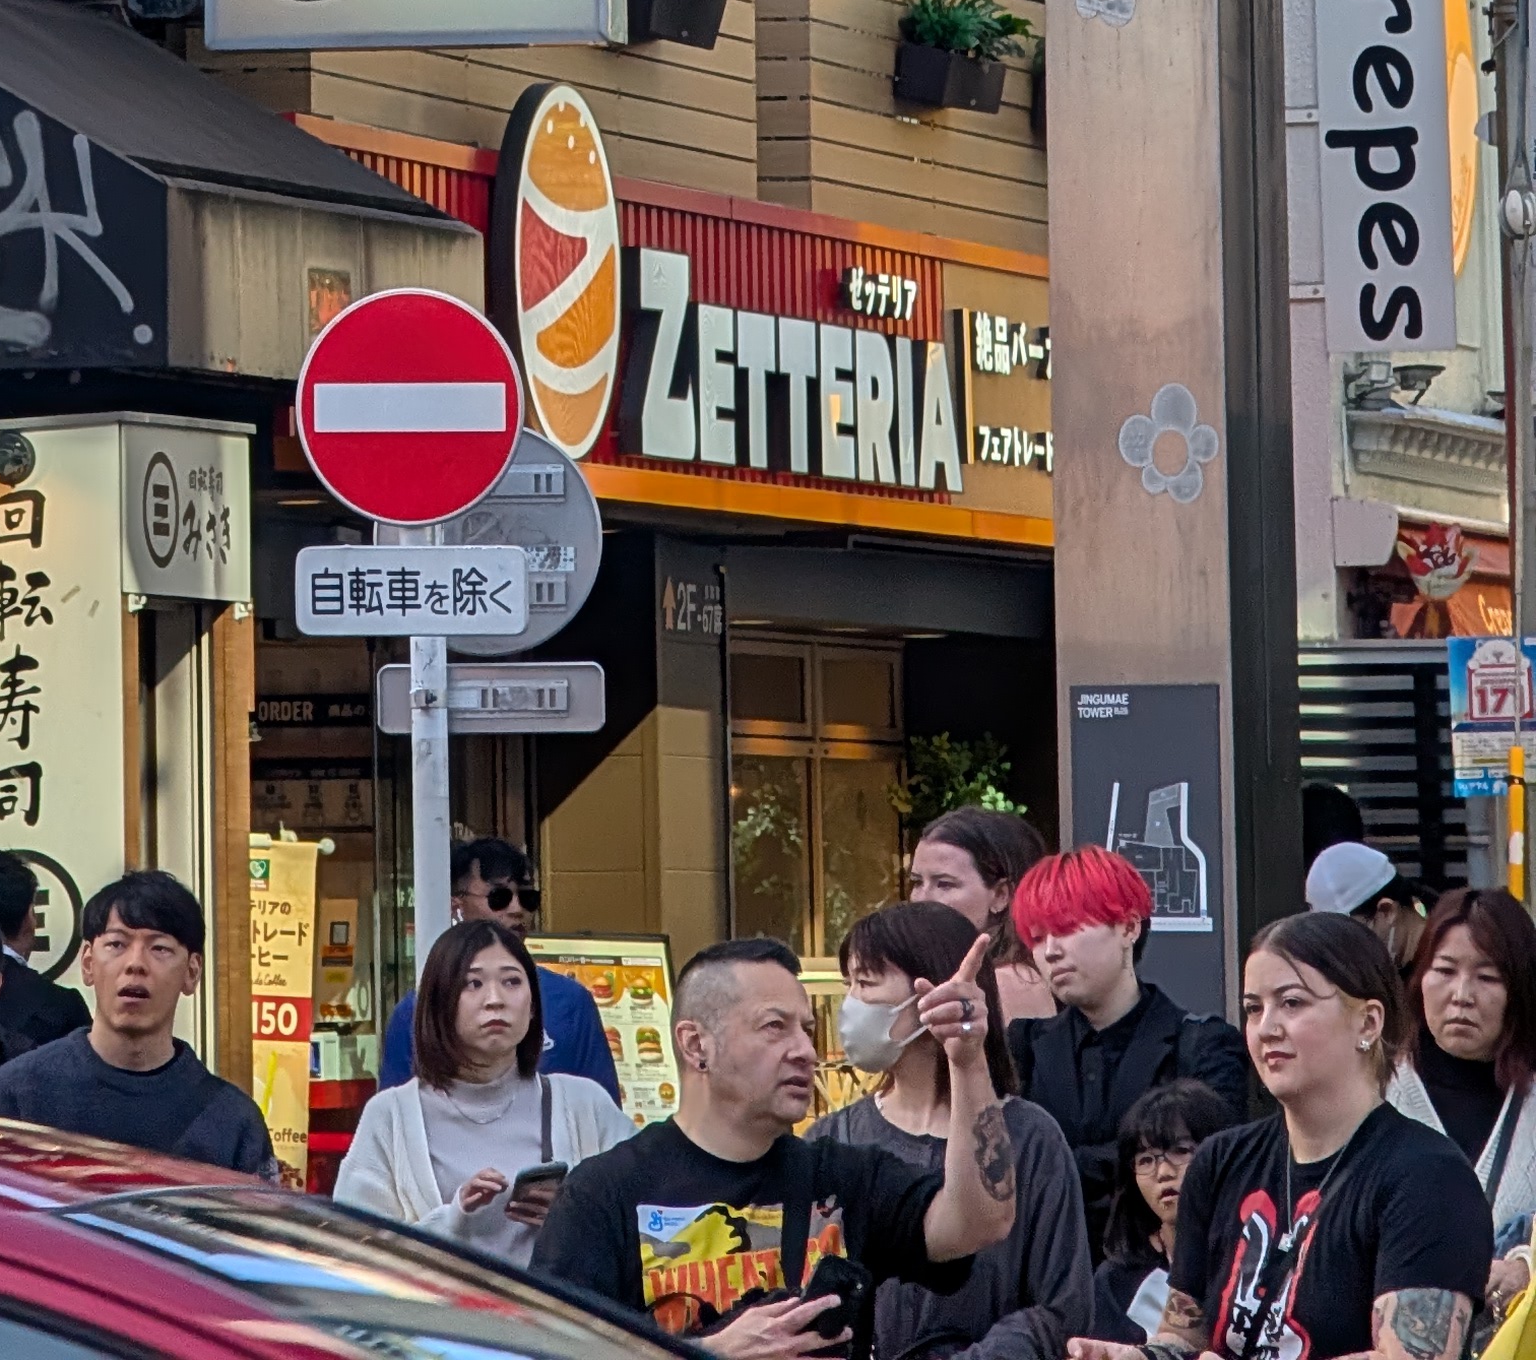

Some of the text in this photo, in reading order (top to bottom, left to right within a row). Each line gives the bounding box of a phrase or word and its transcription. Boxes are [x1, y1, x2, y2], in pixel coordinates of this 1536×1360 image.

[849, 265, 918, 321] ゼッテリア
[639, 247, 964, 494] ZETTERIA
[182, 499, 231, 565] みさき
[310, 566, 512, 617] 自転車を除く
[258, 700, 314, 722] ORDER
[1077, 692, 1130, 706] JINGUMAE
[1077, 706, 1113, 719] TOWER
